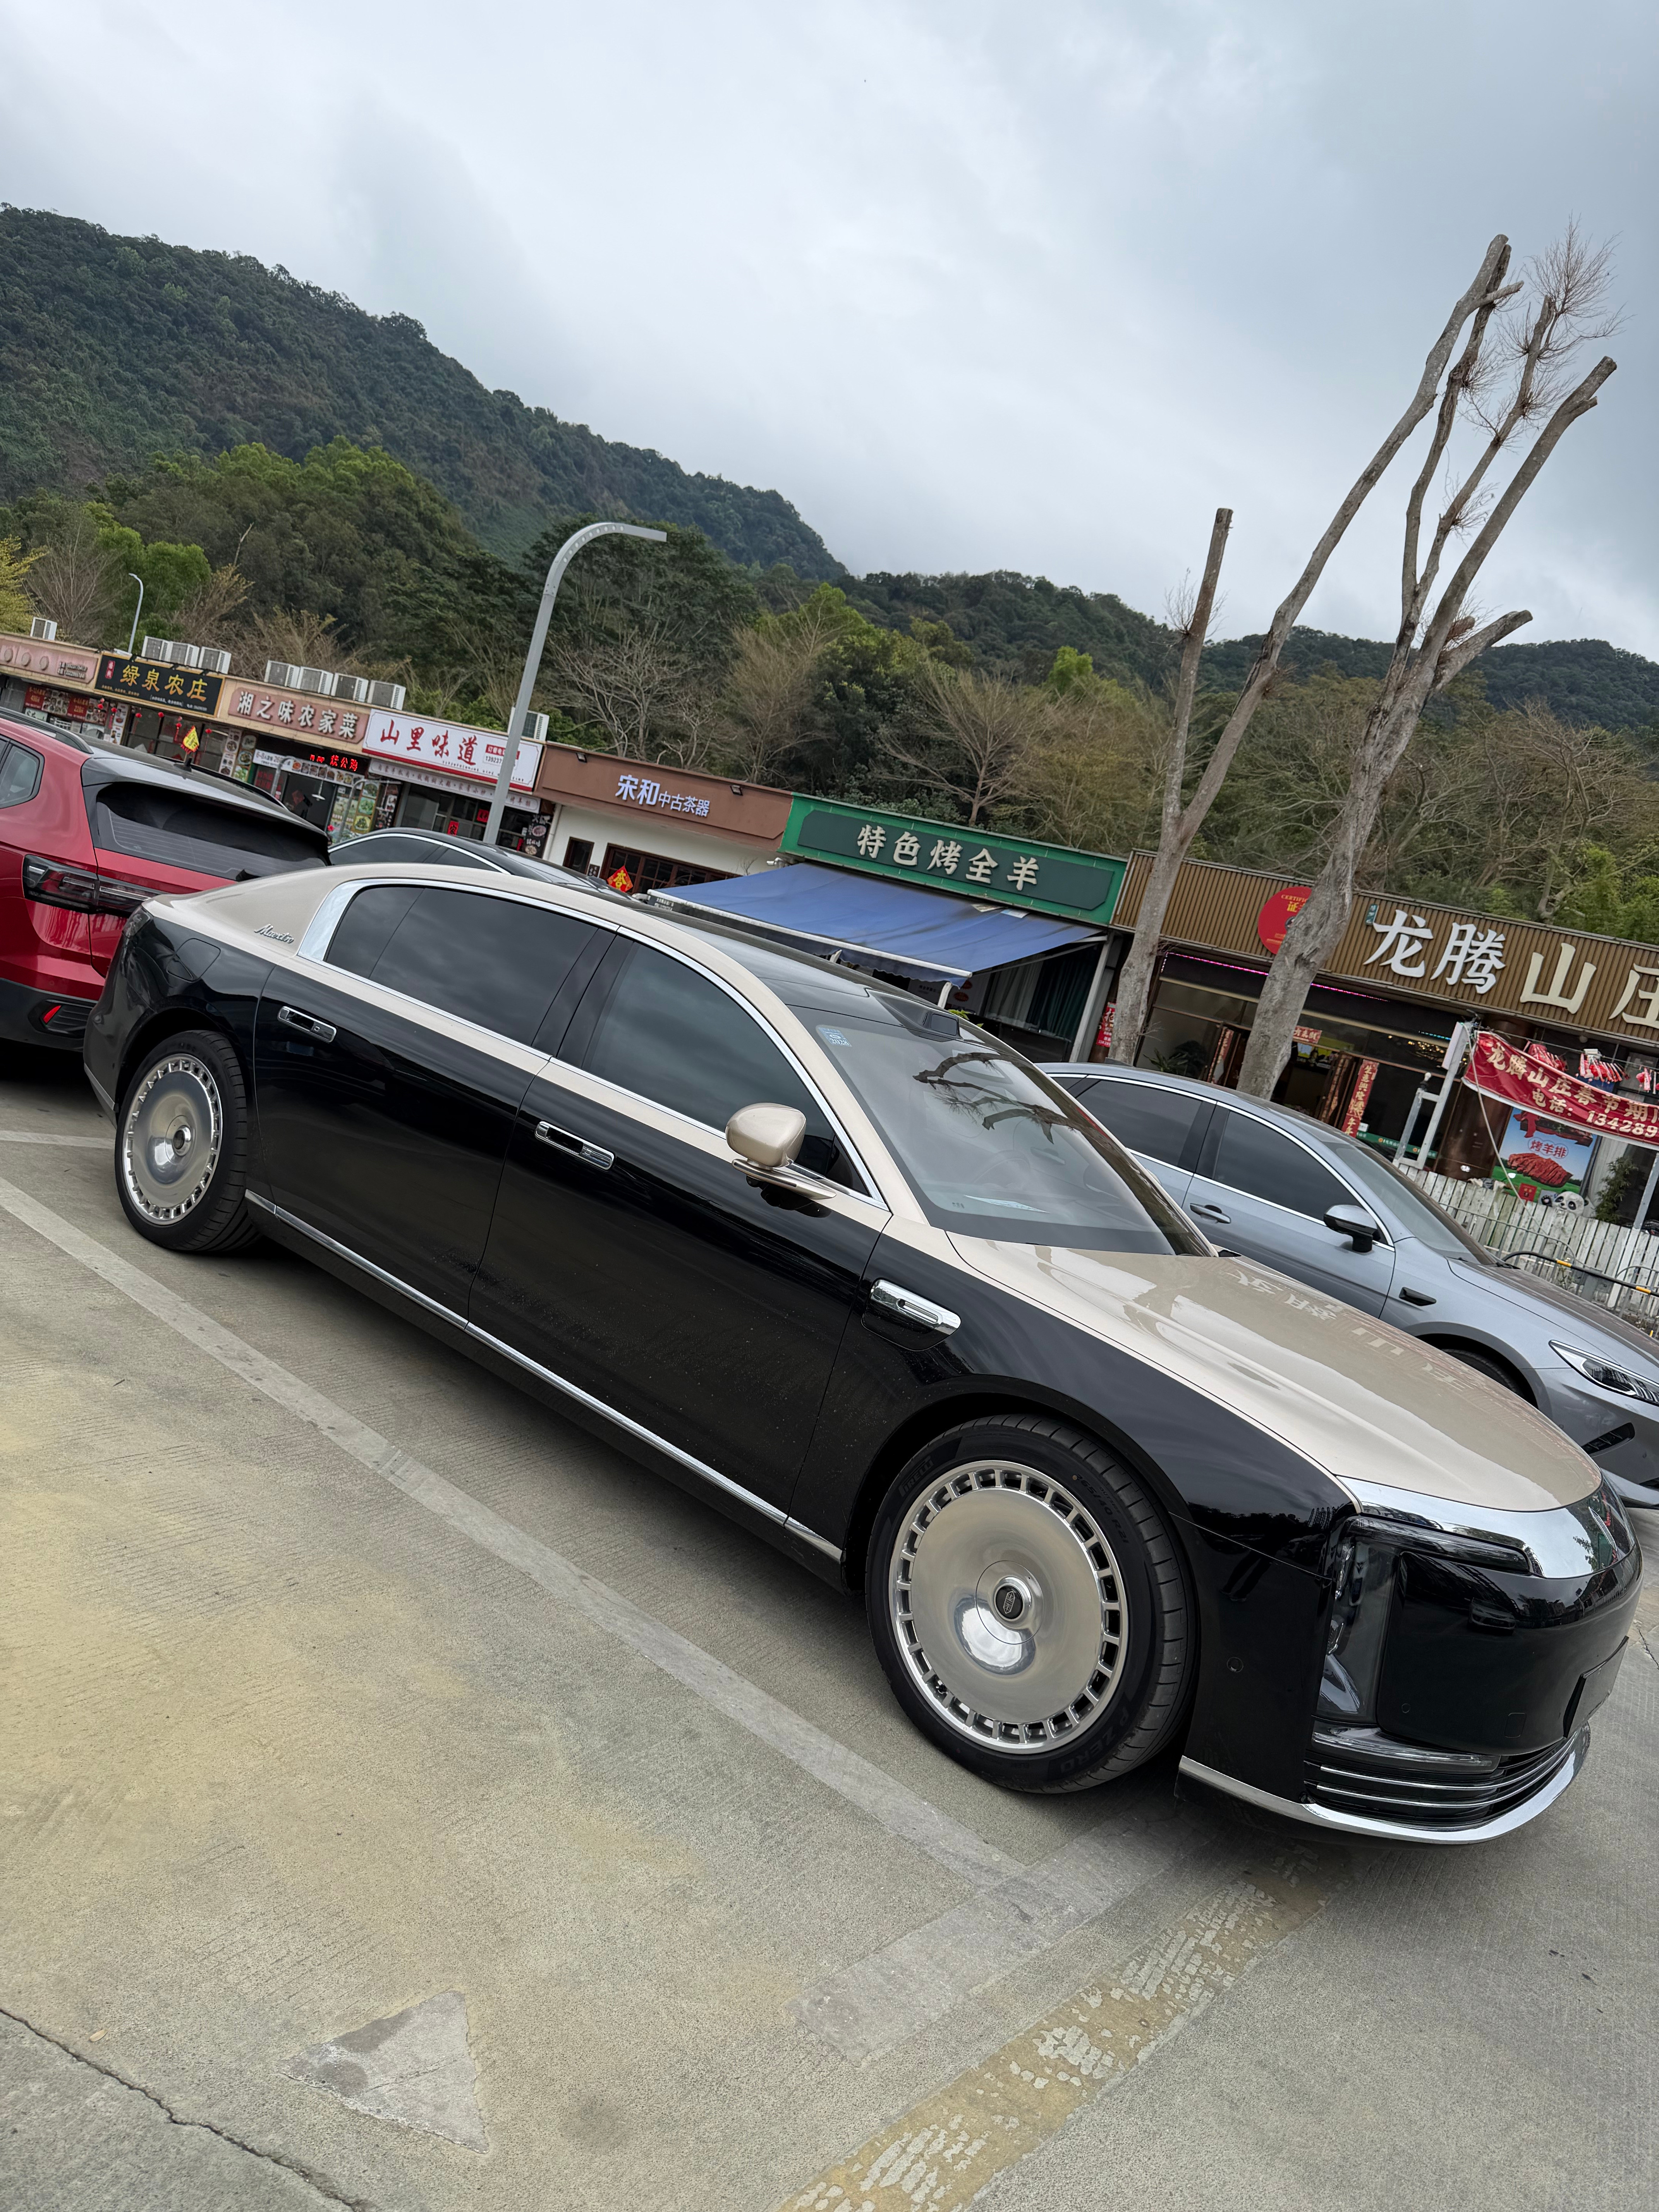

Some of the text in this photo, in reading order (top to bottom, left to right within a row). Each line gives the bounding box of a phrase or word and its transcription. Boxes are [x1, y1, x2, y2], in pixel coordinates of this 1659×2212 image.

[120, 665, 208, 702] 绿泉农庄
[237, 691, 358, 739] 湘之味农家菜
[380, 719, 478, 766] 山里味道
[857, 824, 1040, 891] 特色烤全羊
[1281, 894, 1308, 903] CERTIFIC
[1363, 909, 1659, 1029] 龙腾山庄
[1487, 1042, 1659, 1123] 龙腾山庄春节期
[1530, 1140, 1567, 1158] 烤羊排
[898, 1455, 934, 1497] PIRELLI
[1060, 1726, 1116, 1774] ZERO
